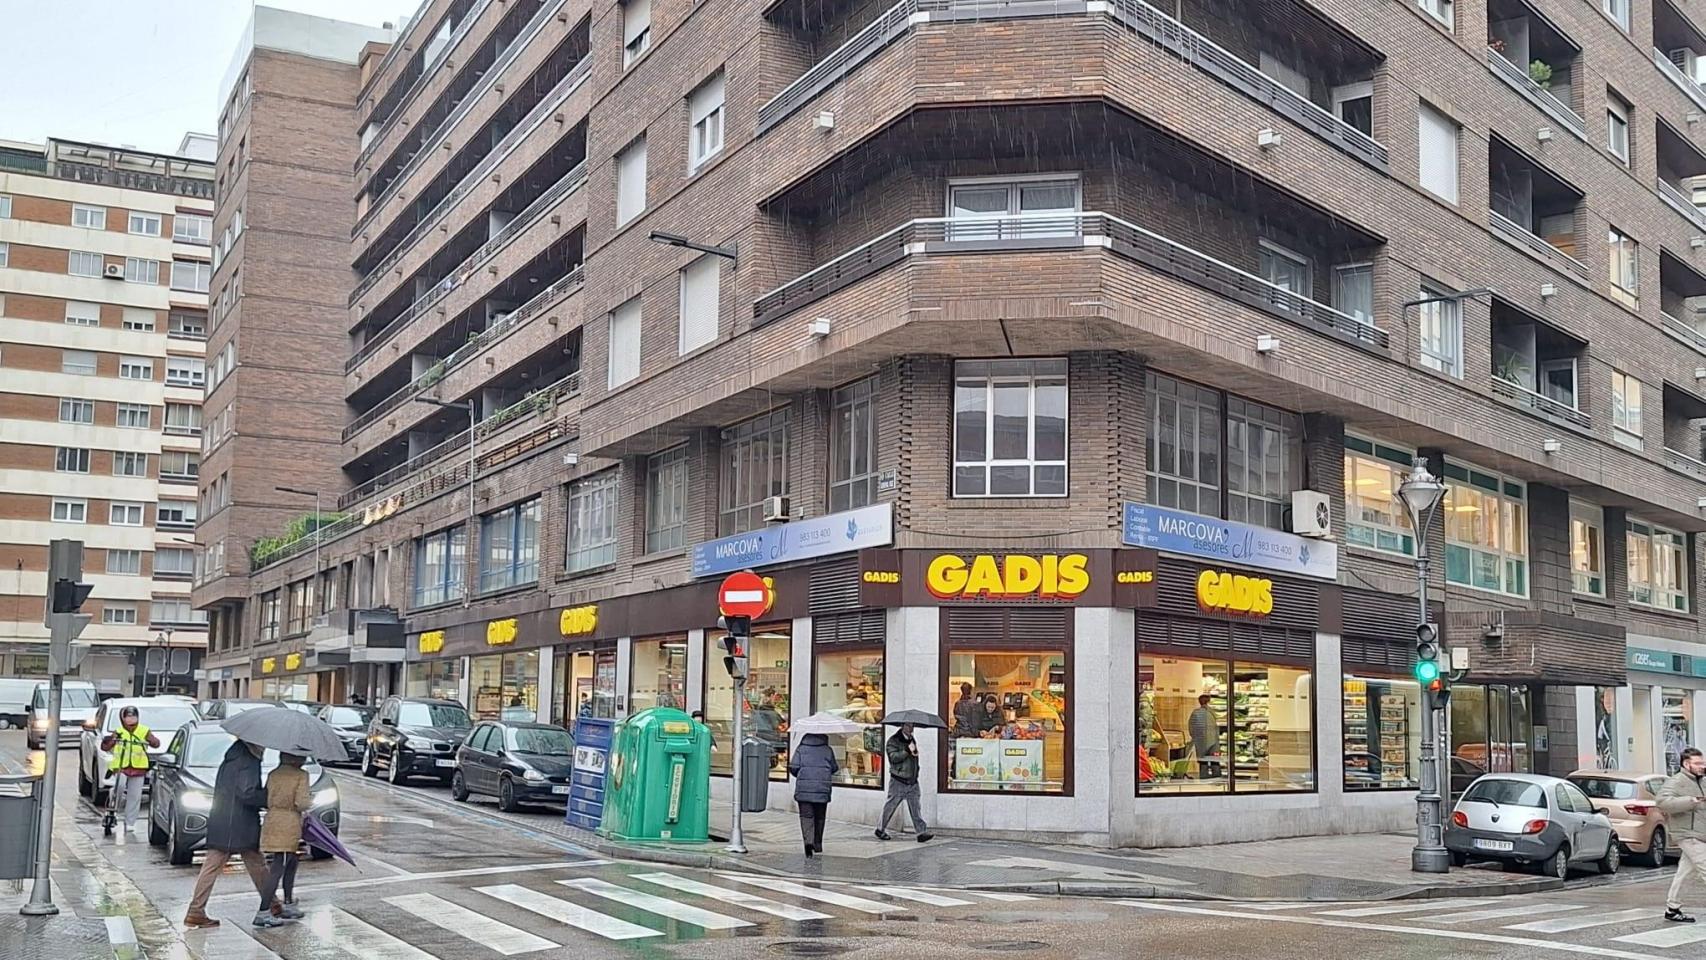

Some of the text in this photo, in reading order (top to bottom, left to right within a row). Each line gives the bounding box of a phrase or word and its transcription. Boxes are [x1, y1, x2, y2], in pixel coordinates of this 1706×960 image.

[1158, 515, 1223, 543] MARCOVA
[716, 538, 758, 560] MARCOVA
[1193, 538, 1229, 555] asesores
[1257, 541, 1269, 551] 983
[1280, 545, 1292, 555] 400
[863, 571, 899, 583] GADIS
[927, 554, 1089, 597] GADIS
[1117, 571, 1153, 583] GADIS
[1198, 570, 1273, 615] GADIS
